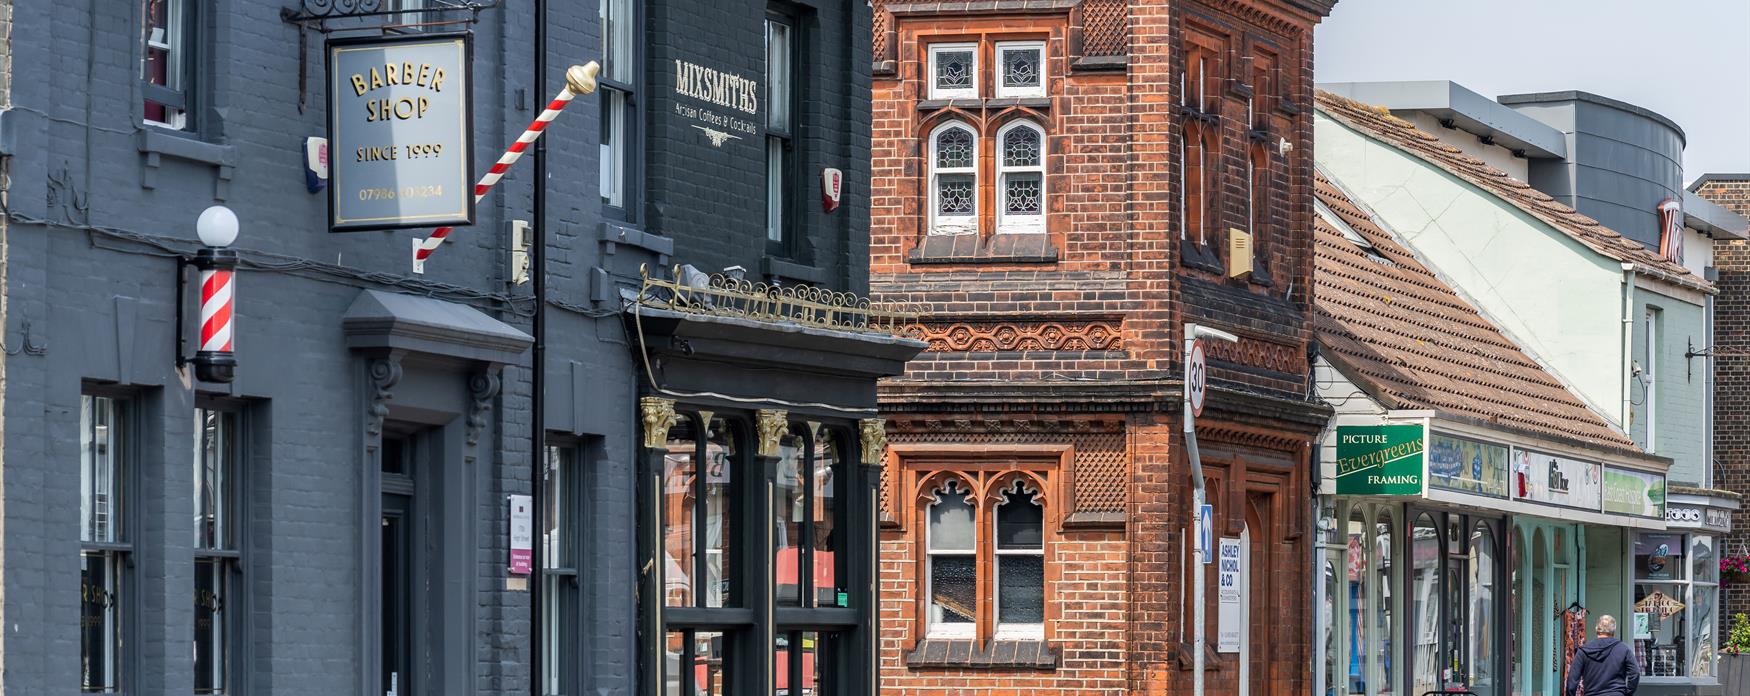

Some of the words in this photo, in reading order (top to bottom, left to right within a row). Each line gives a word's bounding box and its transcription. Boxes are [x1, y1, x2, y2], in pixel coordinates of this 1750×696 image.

[351, 60, 447, 96] BARBER
[675, 59, 757, 114] MIXSMITHS
[366, 97, 430, 122] SHOP
[699, 108, 722, 125] Coffees
[730, 117, 756, 135] Cocktails
[356, 146, 397, 162] SINCE
[406, 143, 443, 159] 1999
[1192, 361, 1203, 393] 30
[1343, 434, 1388, 444] PICTURE
[1338, 438, 1423, 473] Evergreens
[1368, 475, 1418, 485] FRAMING
[1221, 544, 1240, 558] ASHLEY
[1221, 559, 1239, 572] NICHOL
[1221, 574, 1225, 586] &
[1226, 574, 1233, 587] CO
